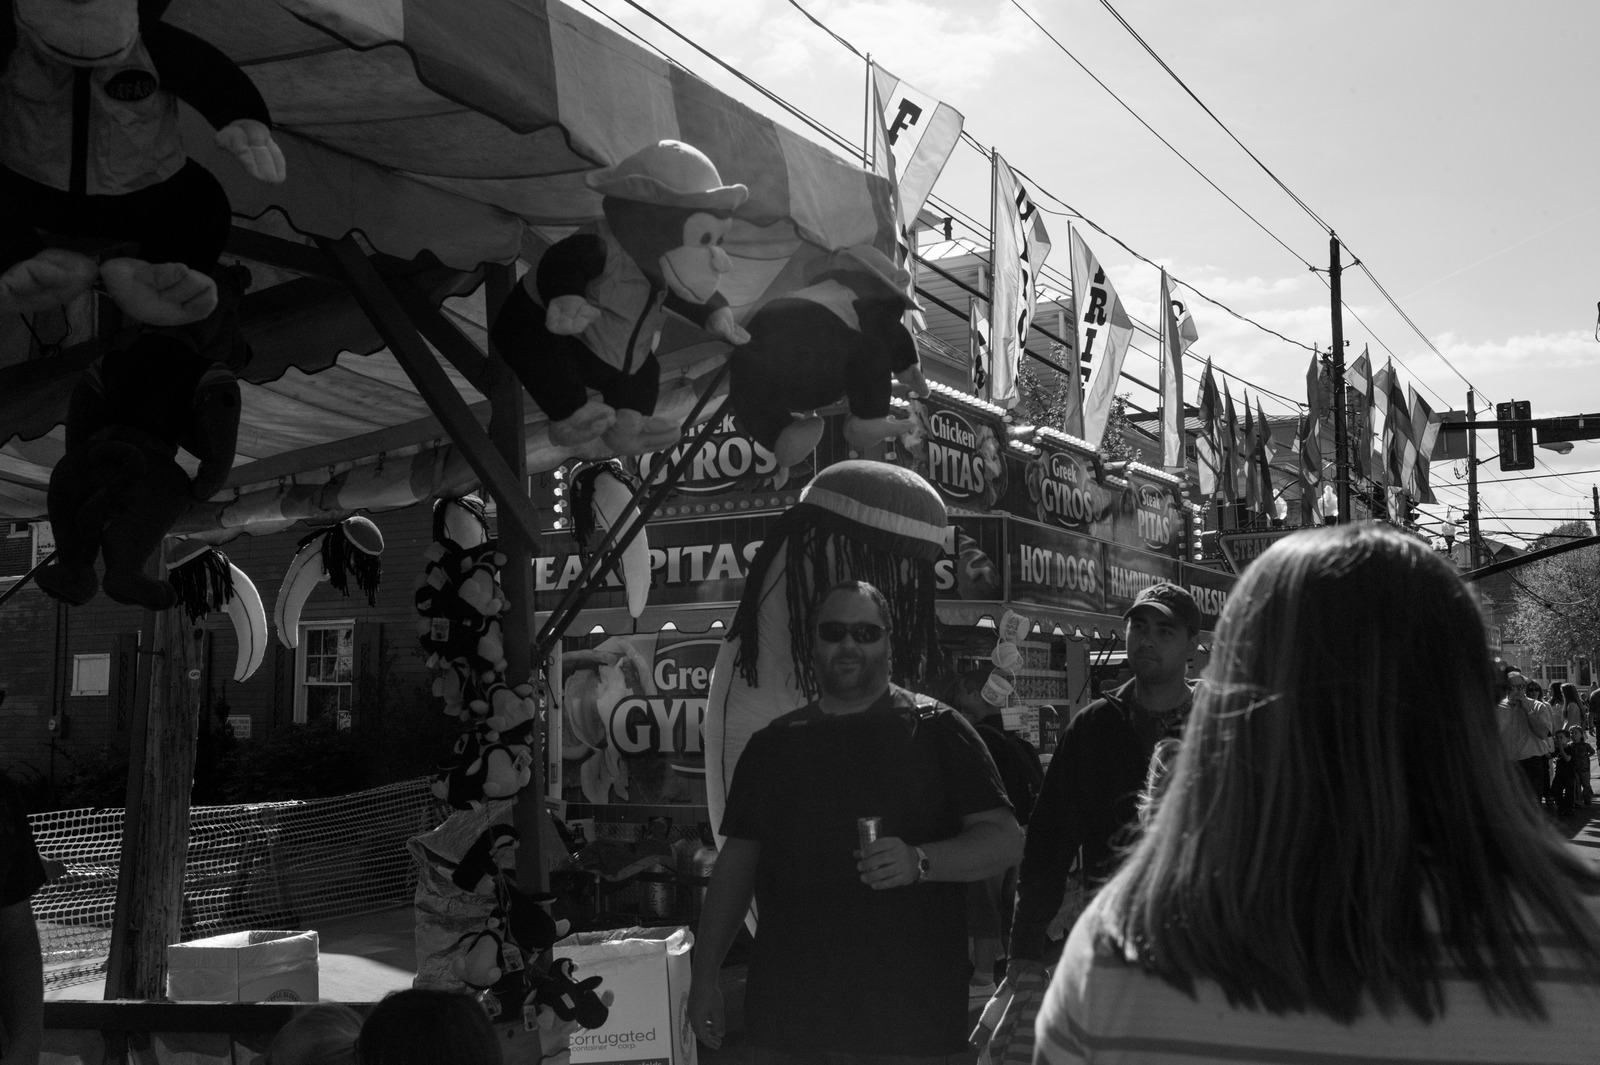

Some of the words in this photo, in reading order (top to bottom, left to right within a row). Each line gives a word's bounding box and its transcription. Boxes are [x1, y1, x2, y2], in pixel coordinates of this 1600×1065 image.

[930, 413, 976, 449] Chicken
[928, 441, 985, 493] PITAS
[1052, 457, 1078, 483] Greek
[1041, 478, 1093, 523] GYROS
[1141, 488, 1160, 510] Steak
[1137, 508, 1170, 544] PITAS
[531, 553, 624, 592] EAK
[1020, 544, 1052, 586] HOT
[1056, 552, 1096, 594] DOGS
[654, 658, 714, 691] Gre
[612, 699, 708, 753] GYR
